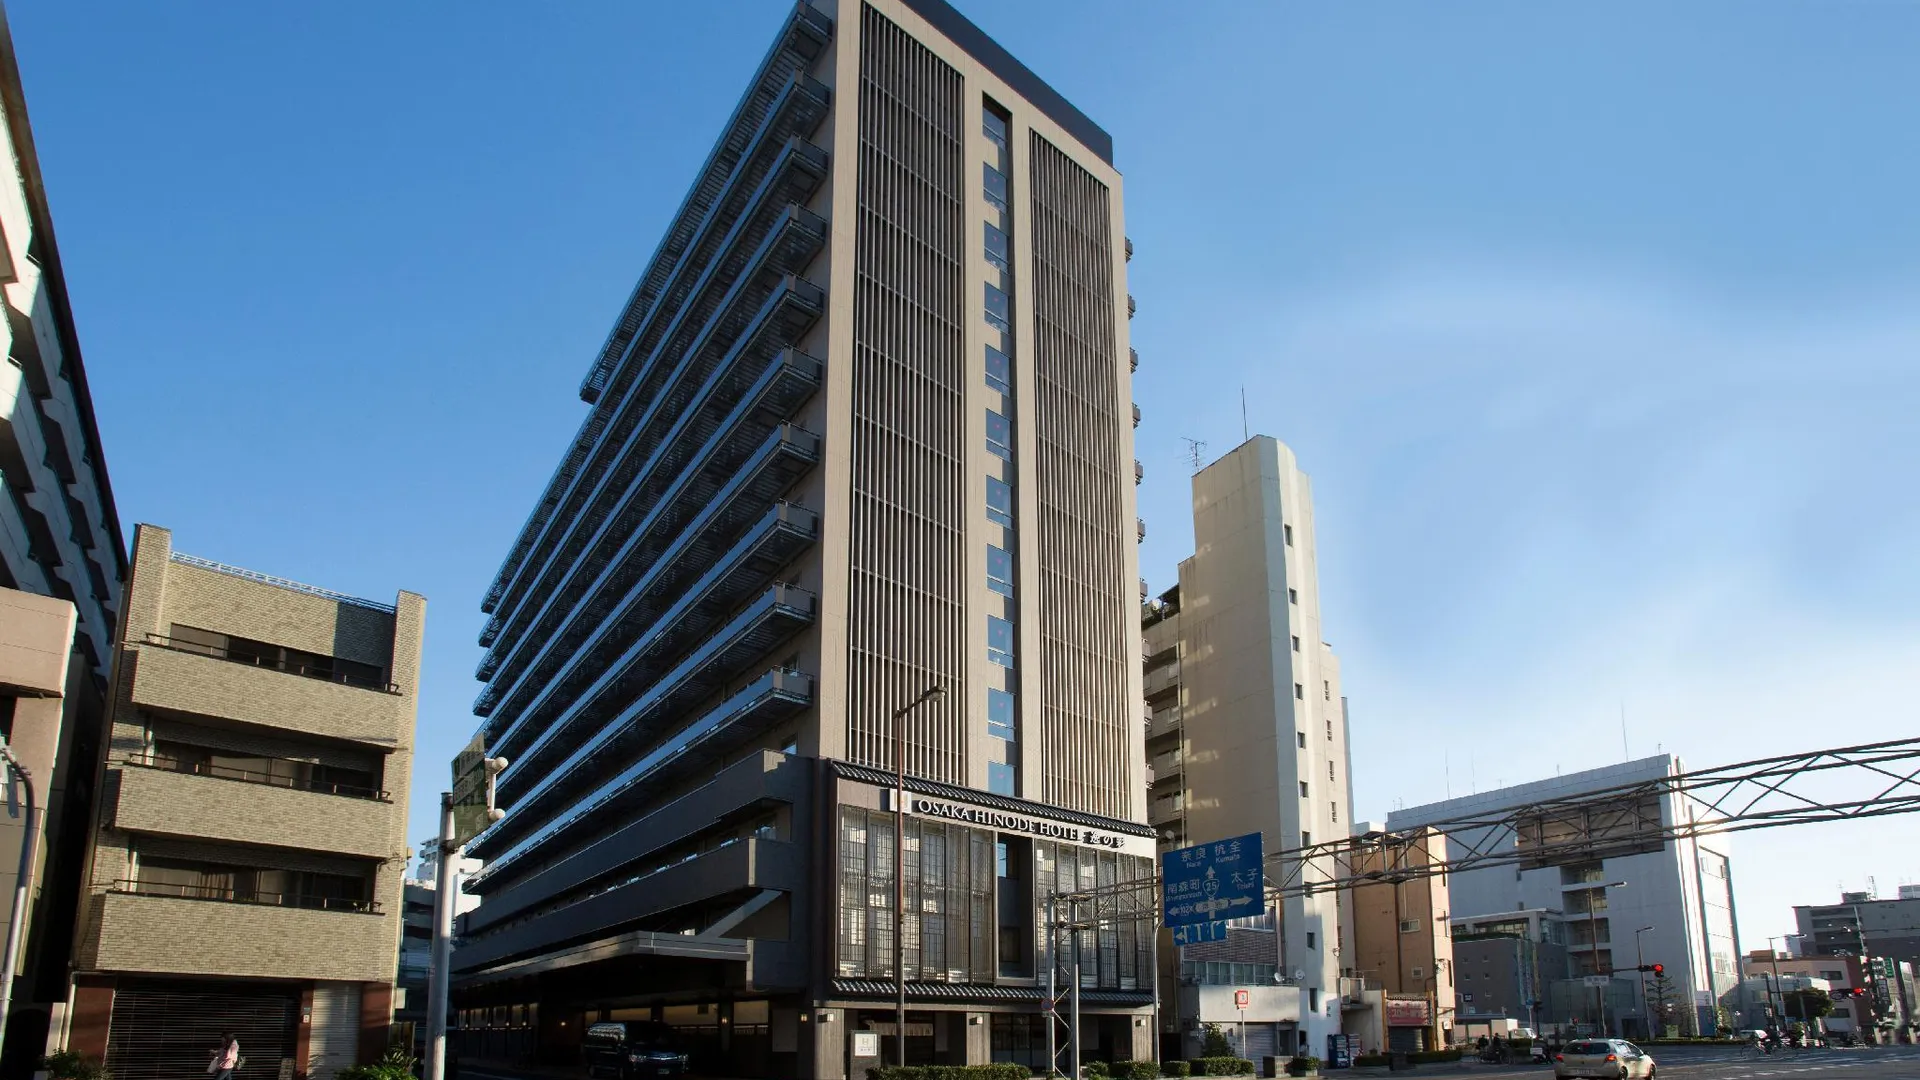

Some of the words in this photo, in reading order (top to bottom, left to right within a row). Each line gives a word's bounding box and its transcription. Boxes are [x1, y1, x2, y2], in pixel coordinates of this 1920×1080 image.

[918, 799, 971, 820] OSAKA
[974, 809, 1036, 833] HINODE
[1039, 822, 1084, 841] HOTEL
[1181, 847, 1206, 862] 奈良
[1214, 841, 1241, 857] 杭全
[1230, 868, 1258, 884] 太子
[1206, 881, 1218, 892] 25
